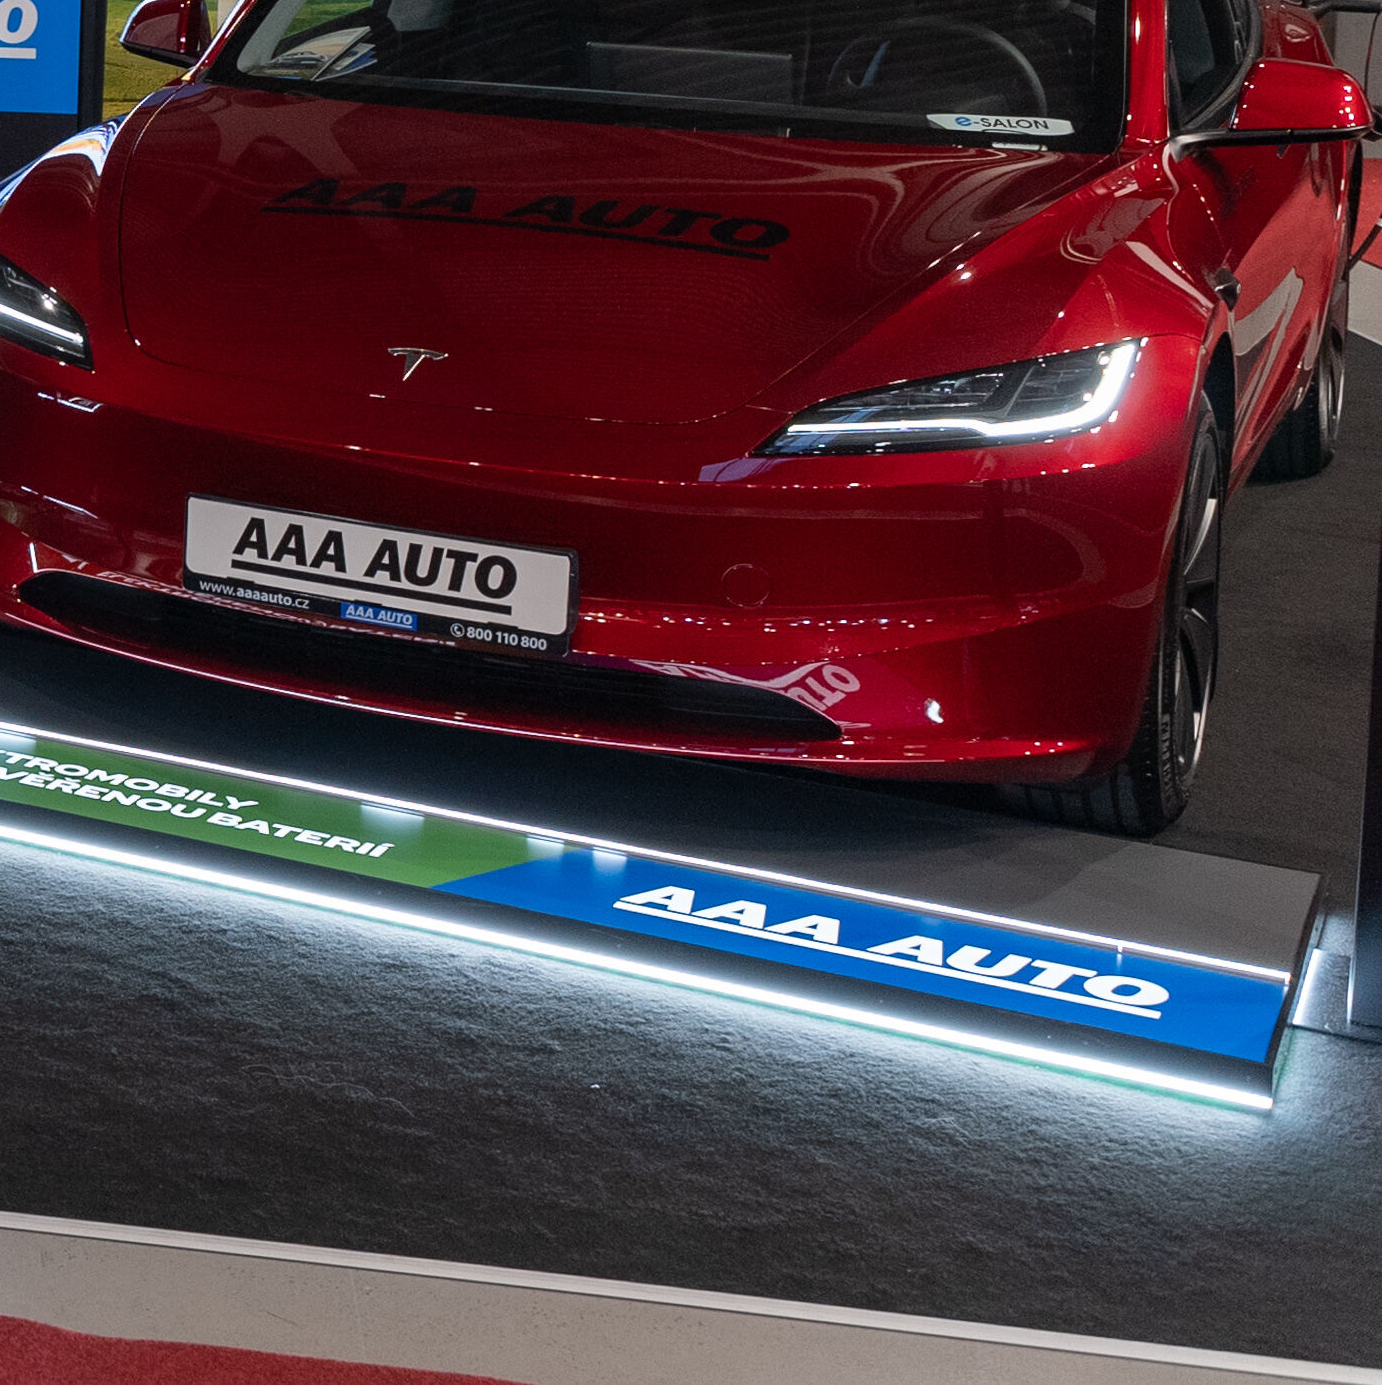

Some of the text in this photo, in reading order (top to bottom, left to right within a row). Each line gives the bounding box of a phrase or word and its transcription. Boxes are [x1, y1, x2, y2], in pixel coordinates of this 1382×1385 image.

[955, 116, 1049, 129] e-SALON
[269, 178, 790, 249] AAA AUTO
[232, 517, 517, 600] AAA AUTO
[199, 579, 310, 610] www.aaaauto.cz
[345, 604, 413, 626] AAA AUTO
[466, 626, 547, 651] 800 110 800
[206, 811, 396, 858] BATERIÍ
[625, 886, 1169, 1006] AAA AUTO
